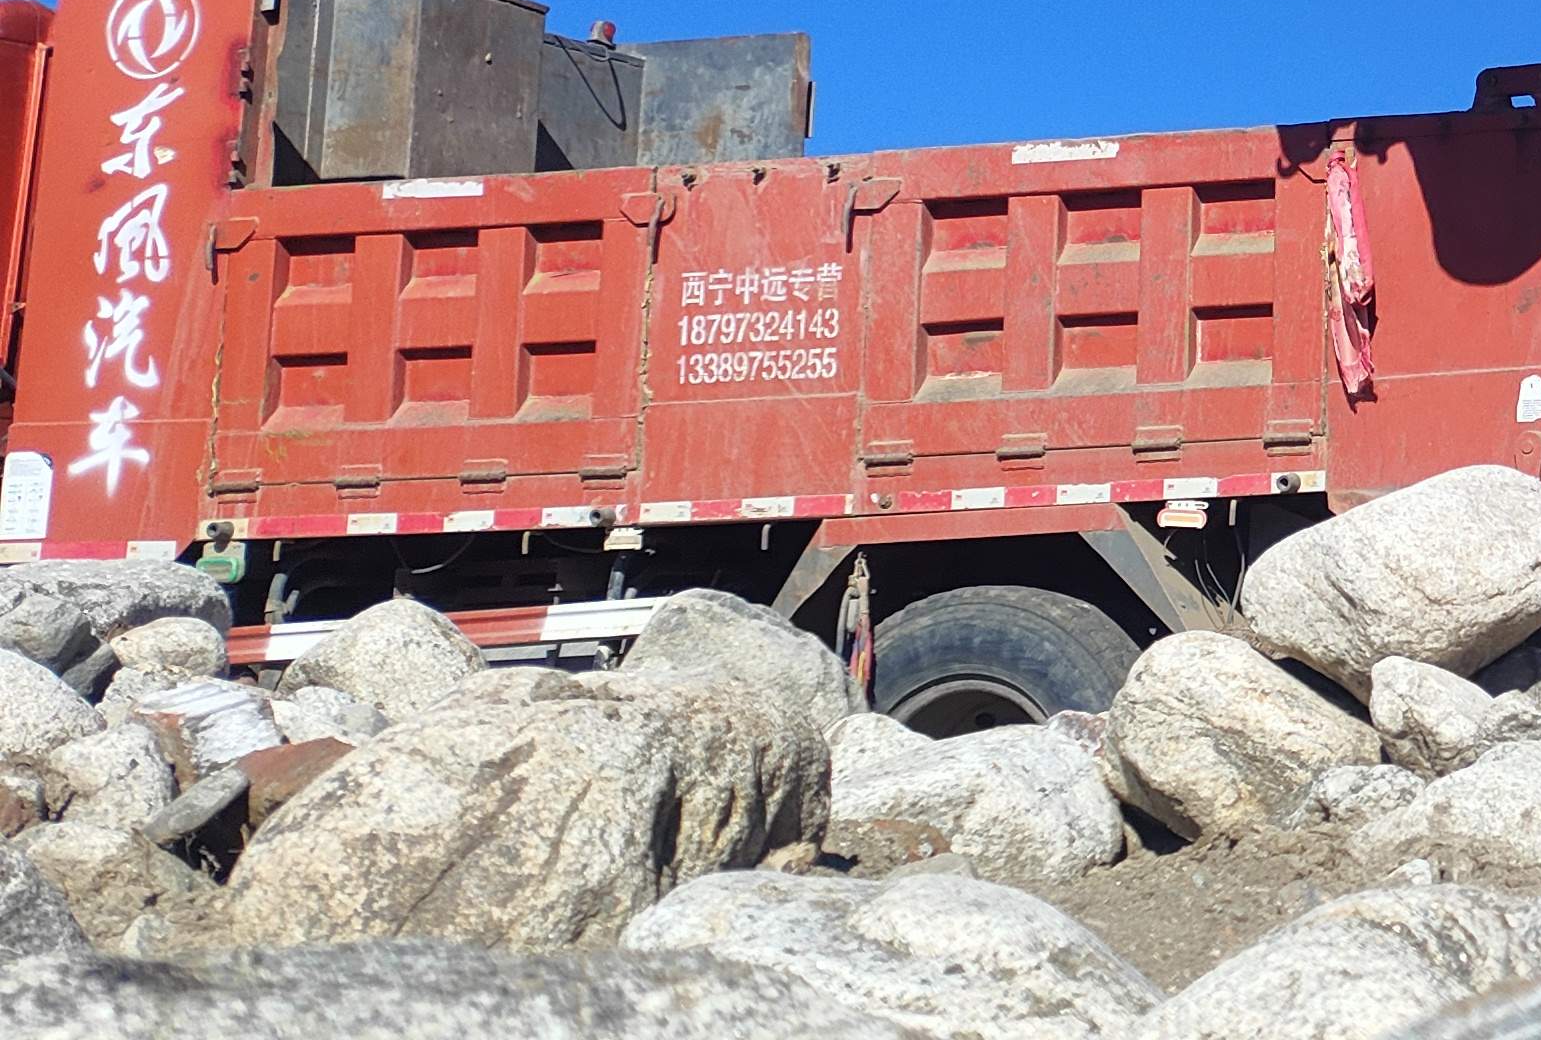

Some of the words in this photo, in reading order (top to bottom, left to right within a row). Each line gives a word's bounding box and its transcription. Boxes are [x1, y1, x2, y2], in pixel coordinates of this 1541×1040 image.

[681, 262, 843, 307] 西宁中远专营
[677, 308, 839, 346] 18797324143
[677, 347, 838, 385] 13389755255
